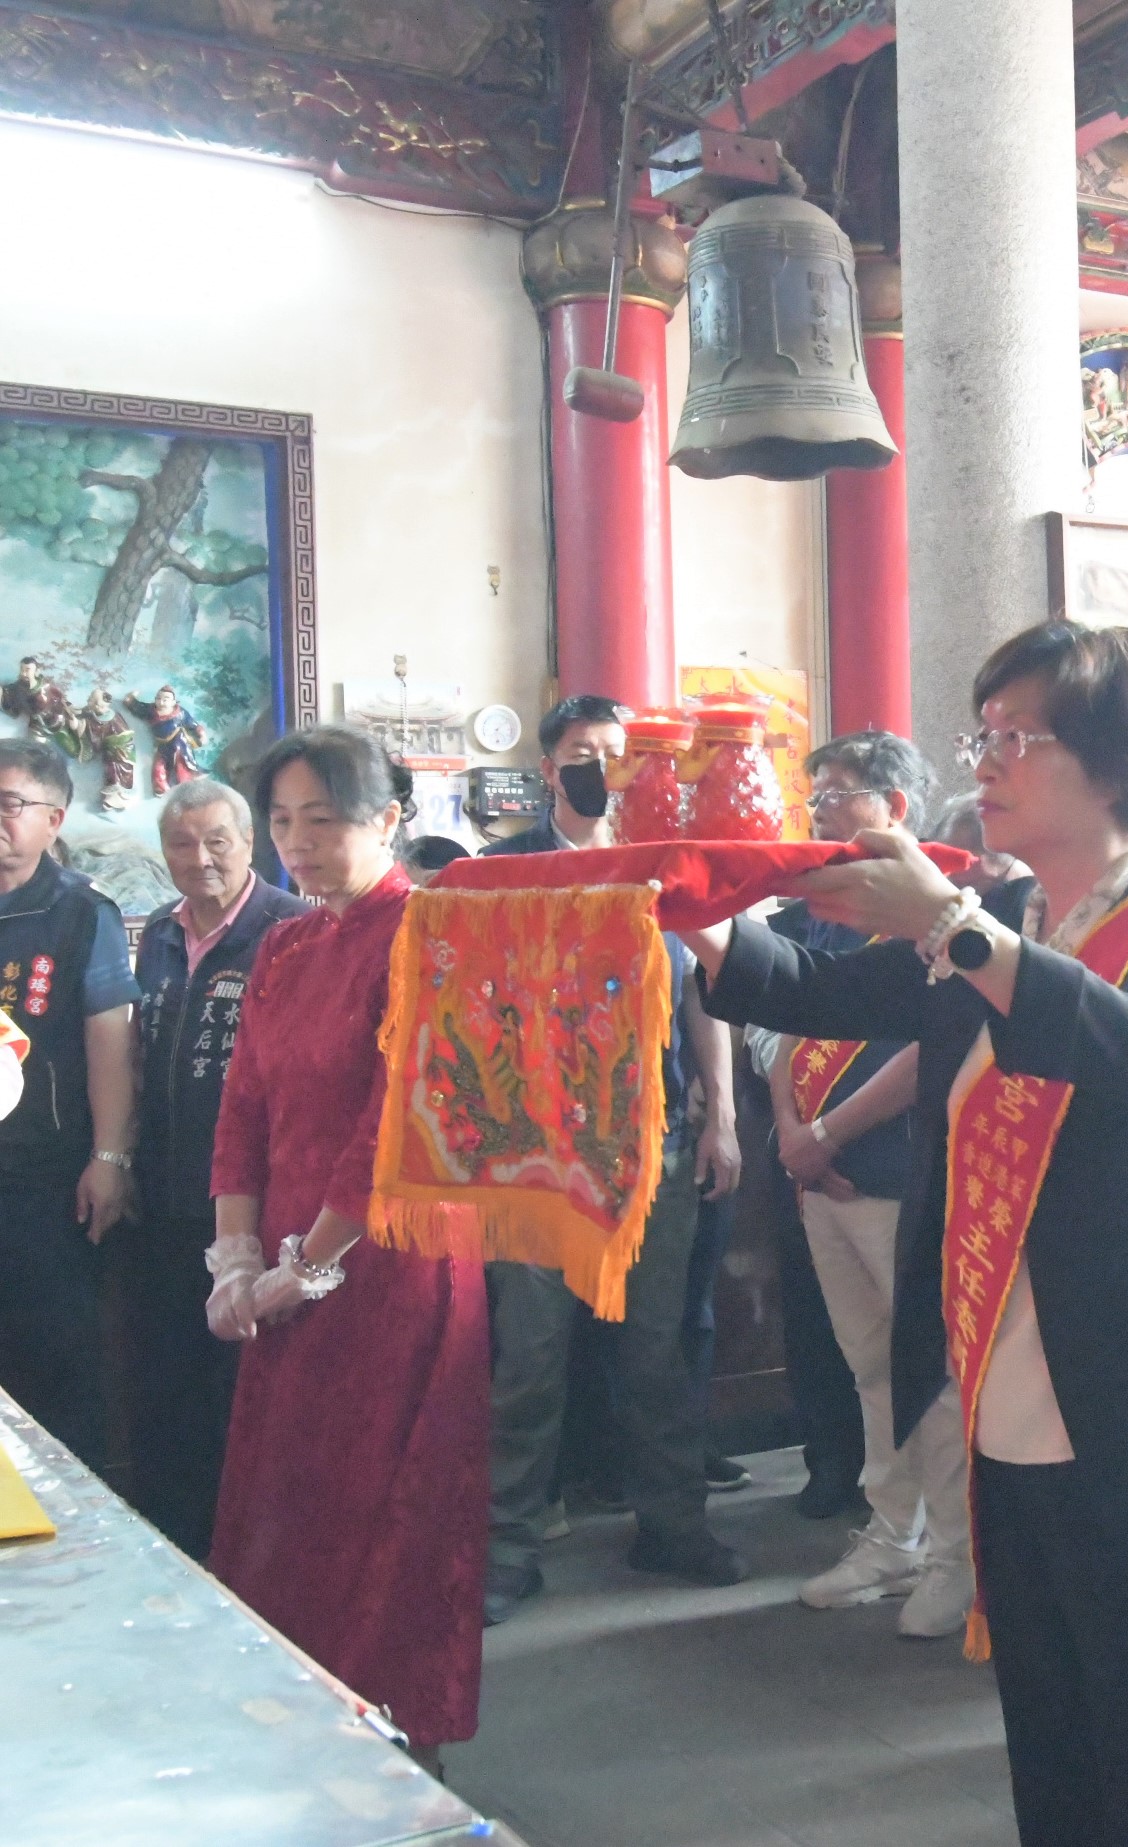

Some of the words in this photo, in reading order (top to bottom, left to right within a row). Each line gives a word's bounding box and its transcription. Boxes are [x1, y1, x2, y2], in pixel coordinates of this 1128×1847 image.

[431, 795, 464, 831] 27
[29, 956, 52, 1014] 南瑤宮
[193, 1001, 216, 1078] 天后宮
